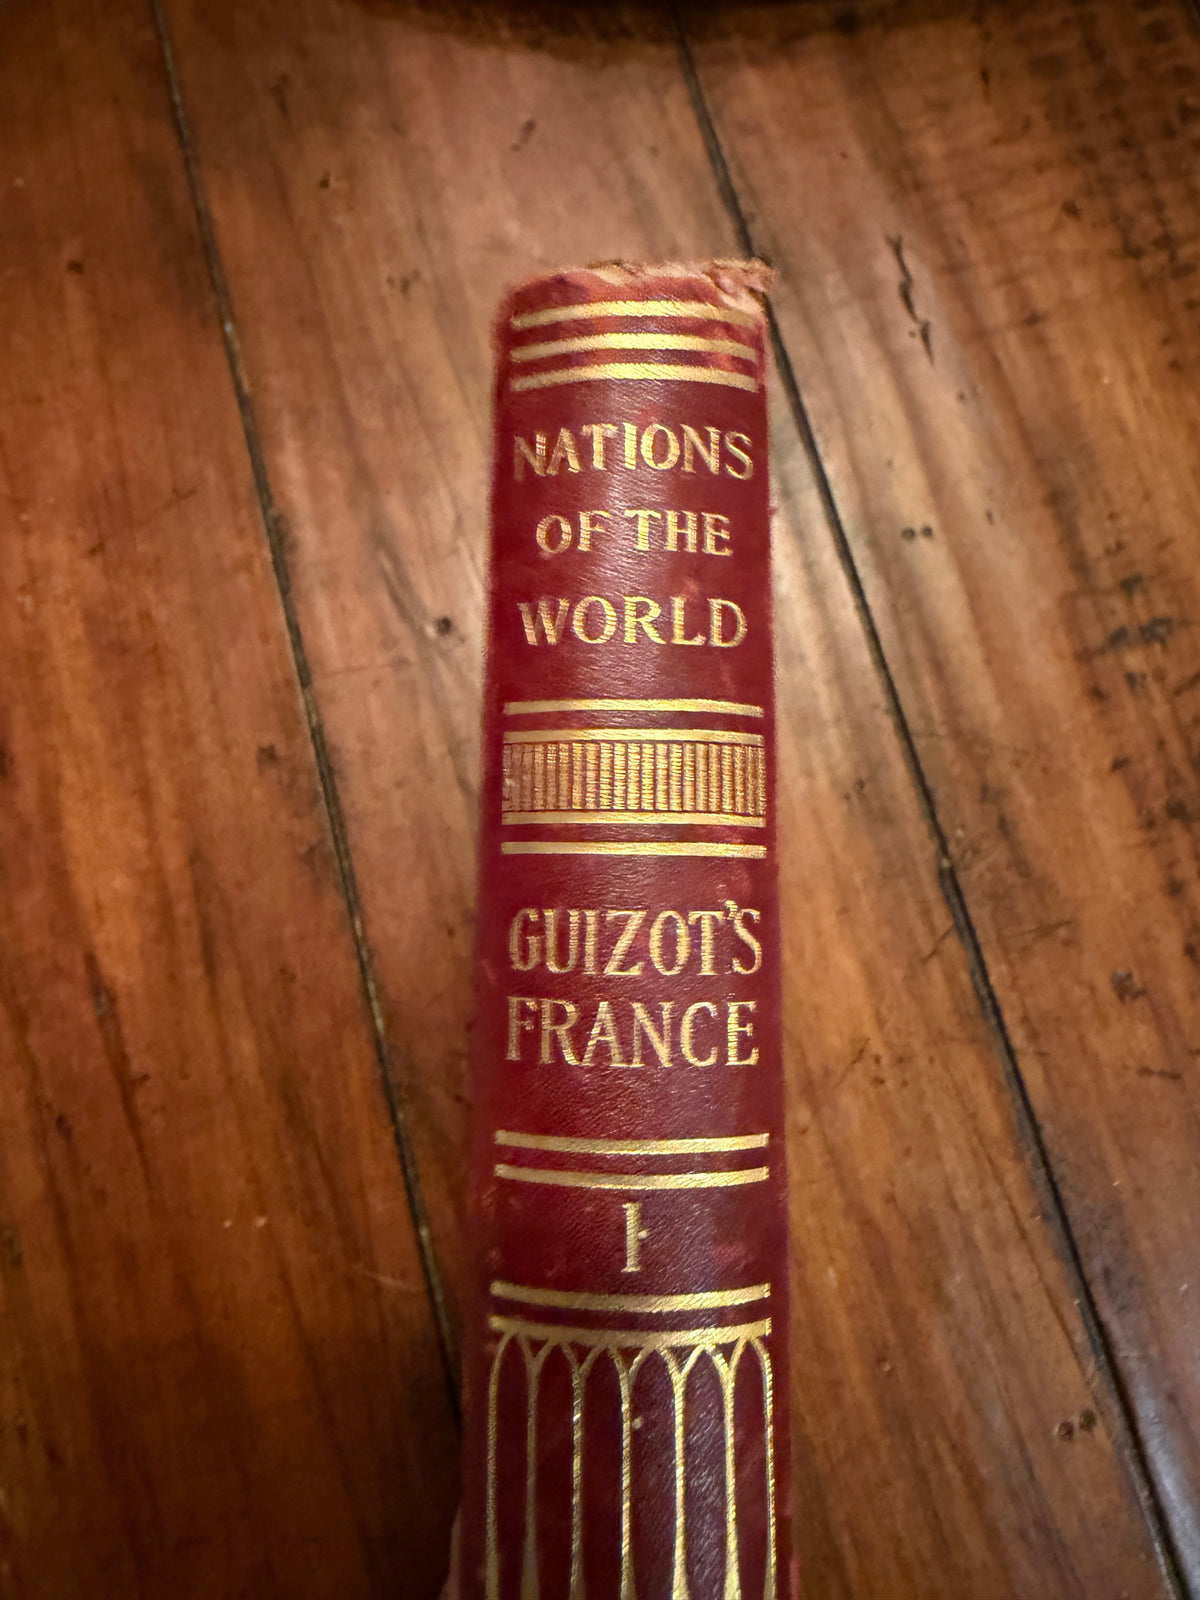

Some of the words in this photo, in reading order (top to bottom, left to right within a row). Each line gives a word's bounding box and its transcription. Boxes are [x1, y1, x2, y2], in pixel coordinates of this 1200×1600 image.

[512, 421, 754, 481] NATIONS
[535, 509, 612, 554] OF
[624, 508, 734, 557] THE
[516, 595, 749, 648] WORLD
[508, 899, 763, 976] GUIZOT'S
[505, 995, 760, 1068] FRANCE
